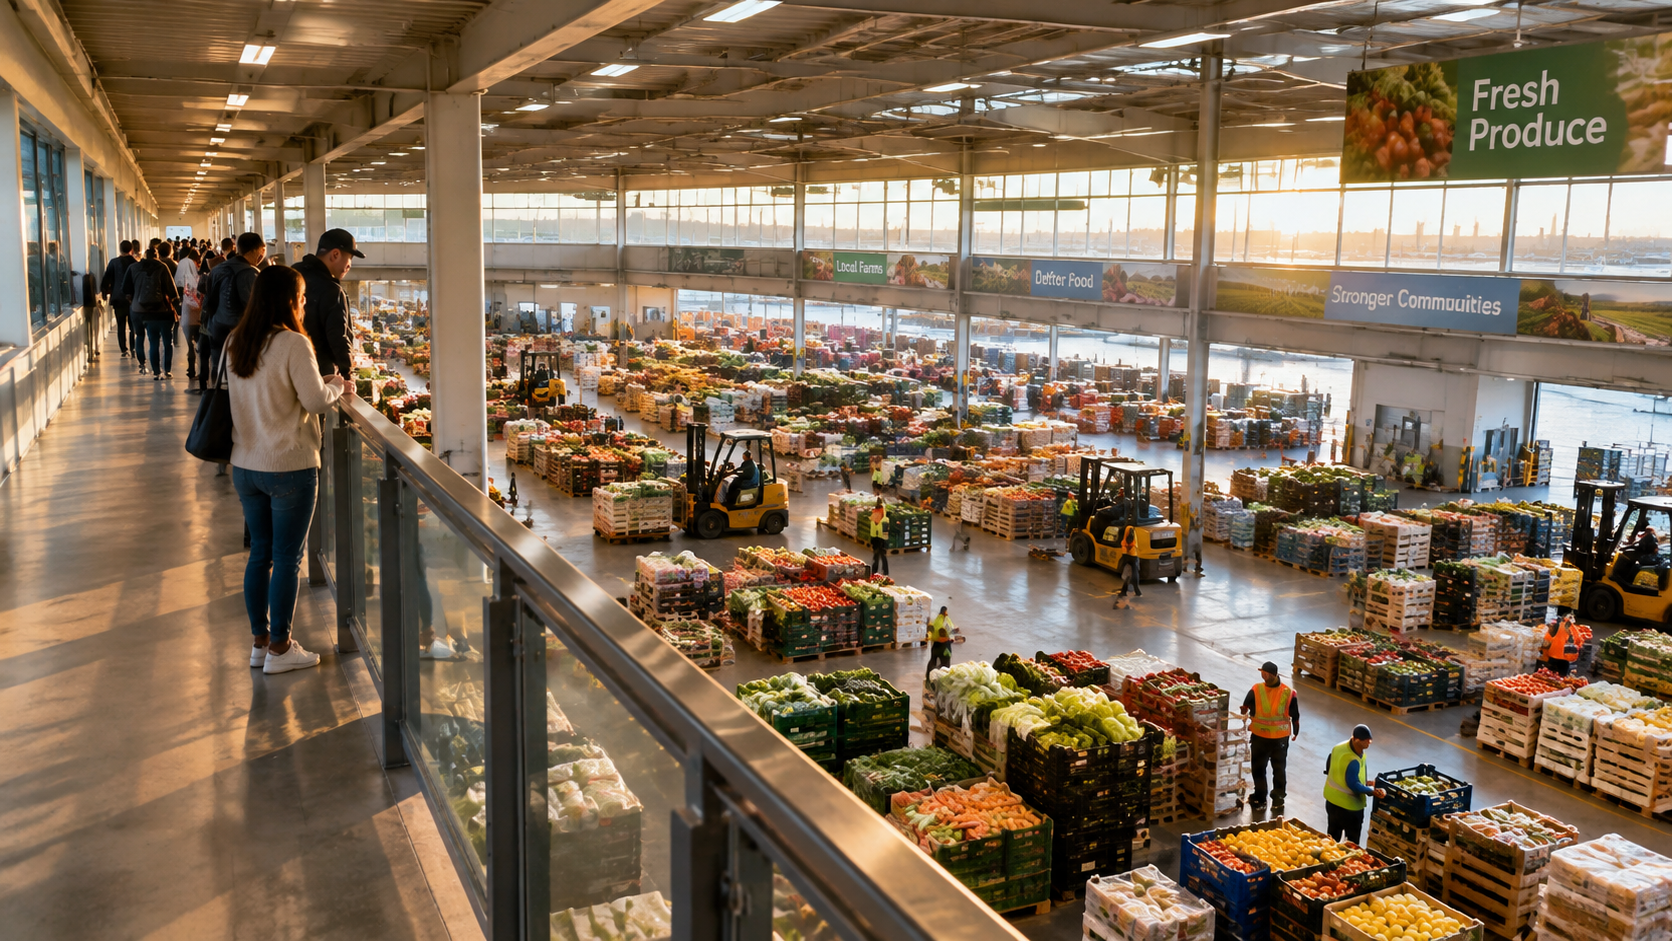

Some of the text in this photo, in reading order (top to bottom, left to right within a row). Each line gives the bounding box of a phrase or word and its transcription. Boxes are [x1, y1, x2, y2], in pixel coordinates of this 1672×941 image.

[1472, 69, 1560, 111] Fresh
[1469, 112, 1607, 151] Produce
[836, 260, 858, 273] Local
[1068, 272, 1094, 289] Food
